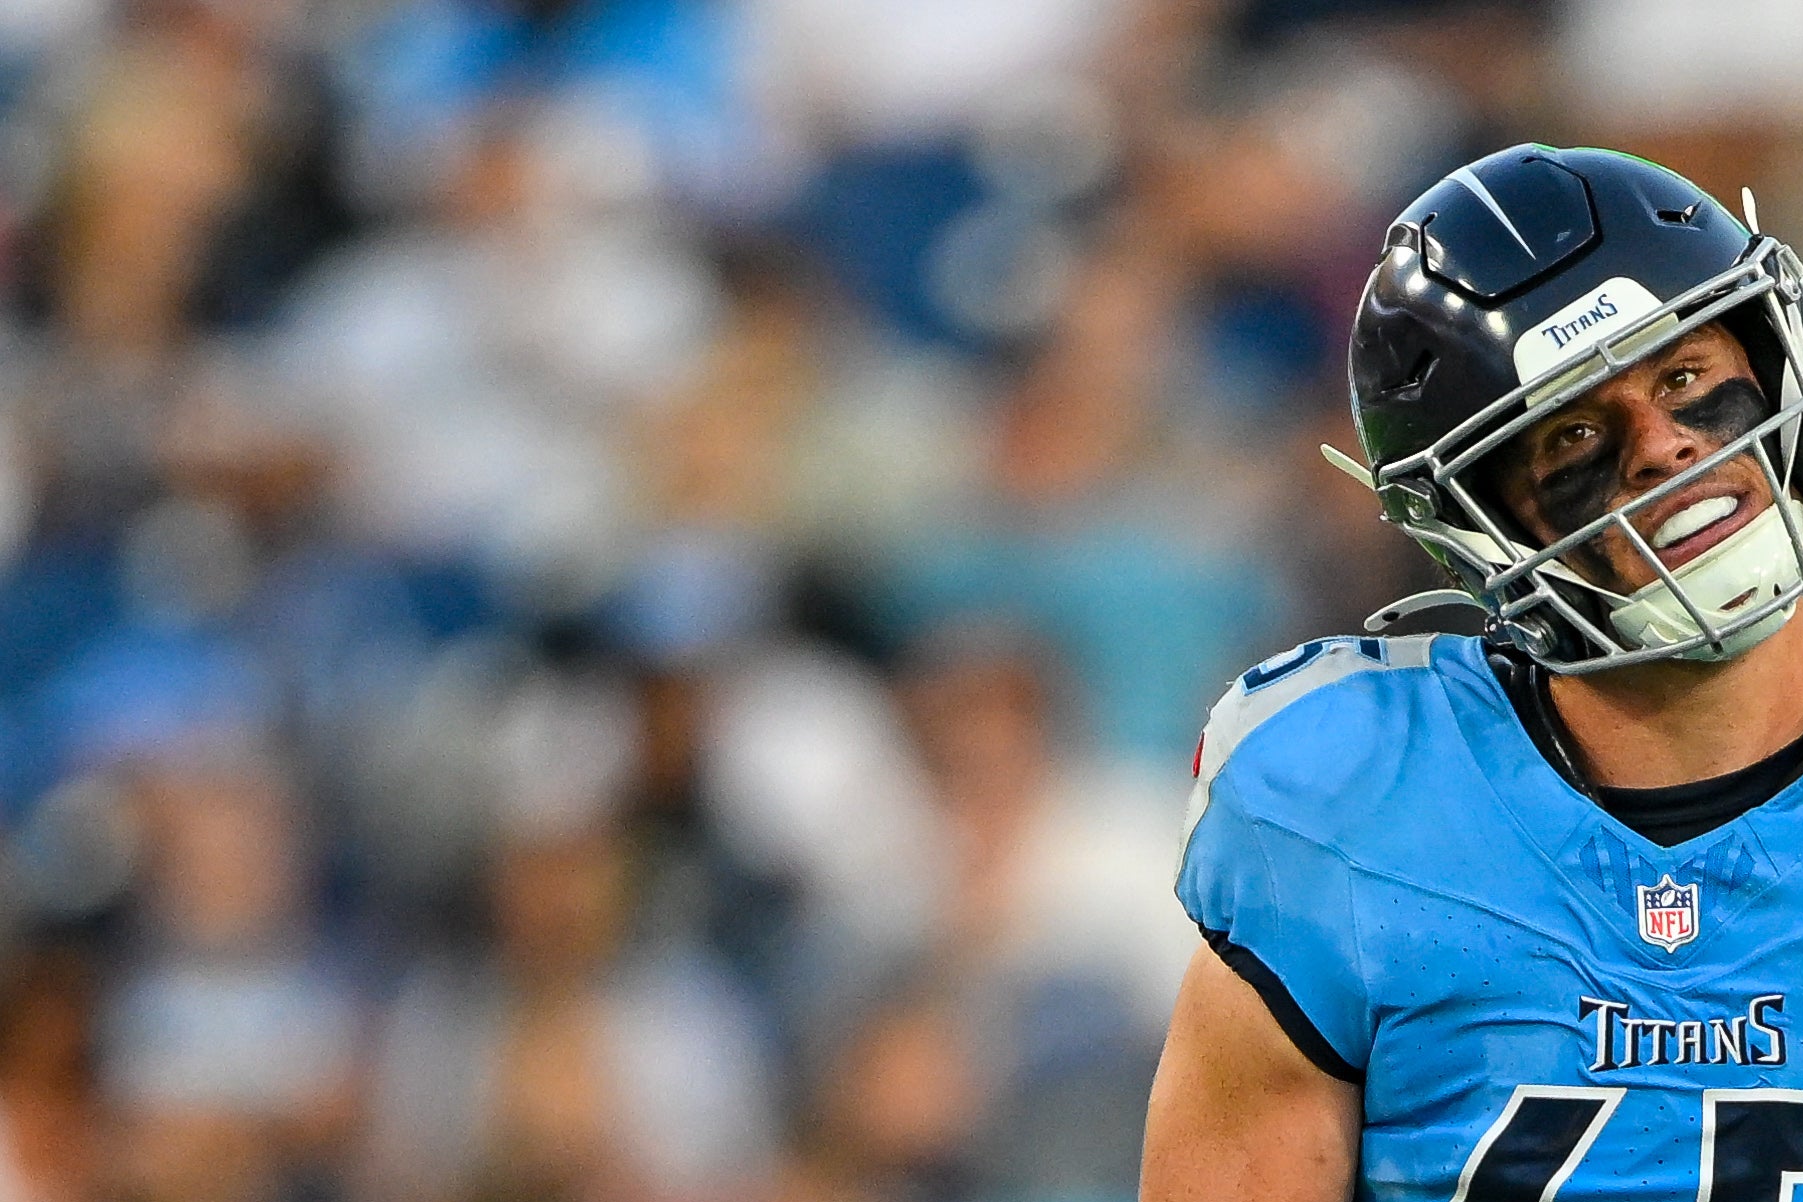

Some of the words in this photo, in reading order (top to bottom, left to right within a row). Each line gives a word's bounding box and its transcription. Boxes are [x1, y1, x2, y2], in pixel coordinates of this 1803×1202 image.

[1541, 293, 1619, 350] TITANS
[1649, 910, 1690, 938] NFL
[1578, 994, 1787, 1073] TITANS
